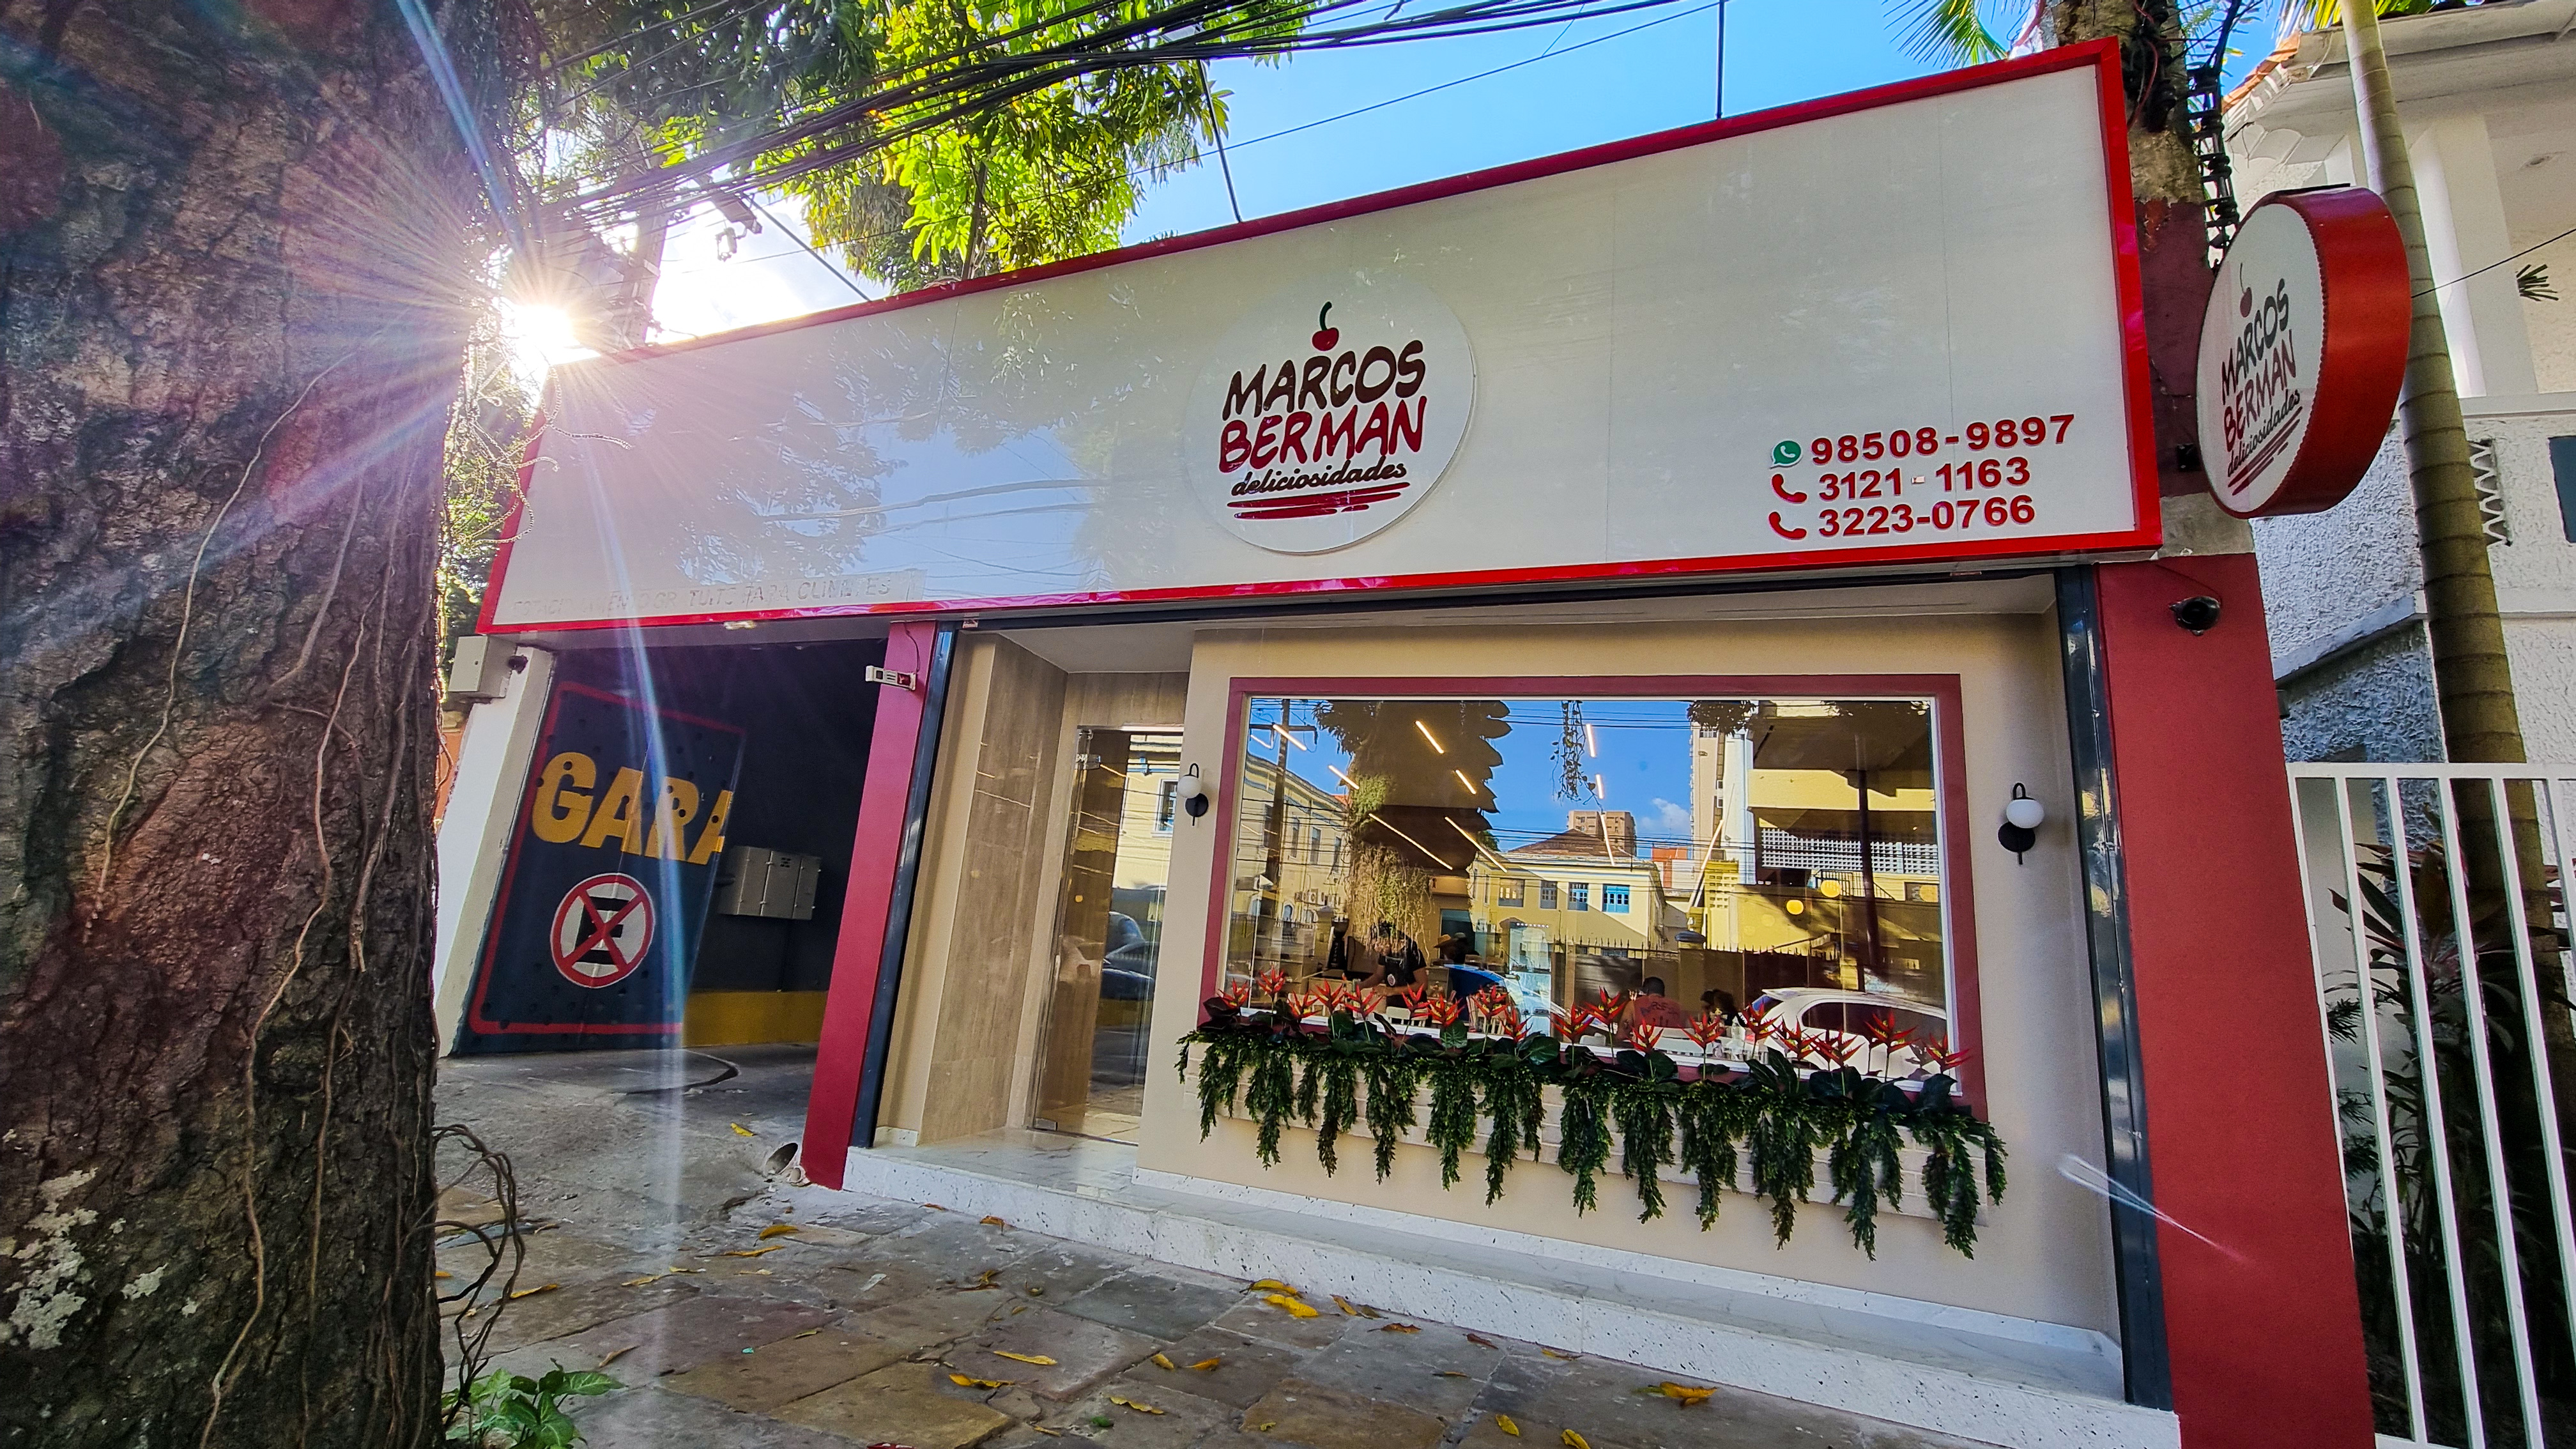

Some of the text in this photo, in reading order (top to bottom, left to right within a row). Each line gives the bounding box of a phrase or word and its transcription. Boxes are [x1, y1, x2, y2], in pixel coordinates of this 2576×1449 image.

[1222, 339, 1427, 421] MARCOS
[2221, 278, 2289, 404] MARCOS
[2223, 329, 2296, 452] BERMAN
[1218, 395, 1428, 473] BERMAN
[1811, 413, 2075, 466] 98508-9897
[2227, 388, 2301, 477] deliciosidades
[1230, 455, 1408, 496] deliciosidades
[1818, 494, 2035, 537] 3223-0766
